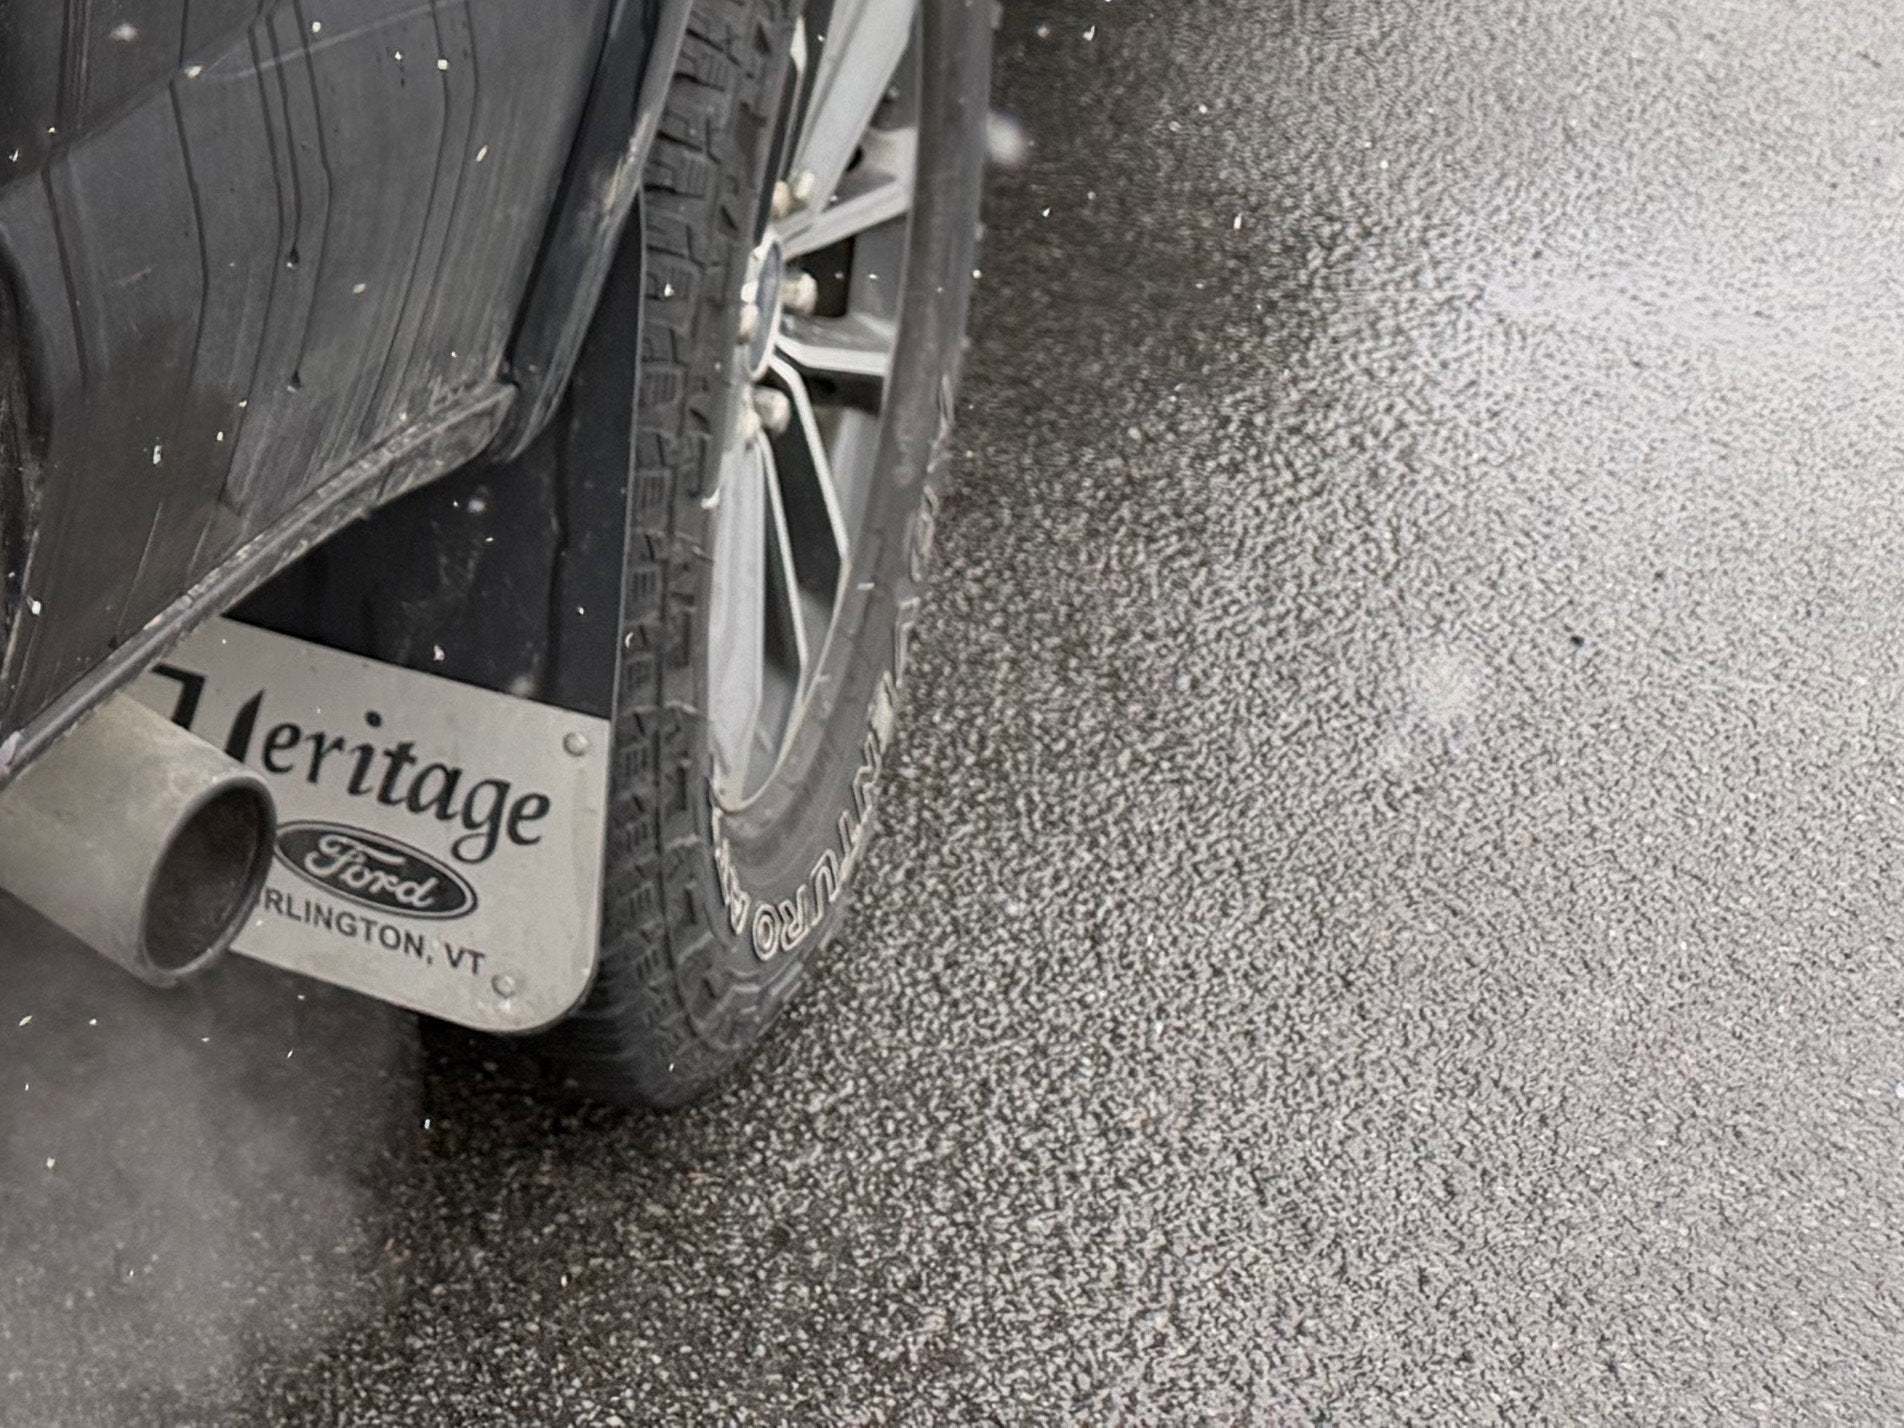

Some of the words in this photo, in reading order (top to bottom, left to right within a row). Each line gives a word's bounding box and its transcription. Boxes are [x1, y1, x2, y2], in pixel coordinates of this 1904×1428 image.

[303, 832, 440, 908] Ford
[263, 887, 433, 966] RLINGTON,
[444, 942, 486, 975] VT
